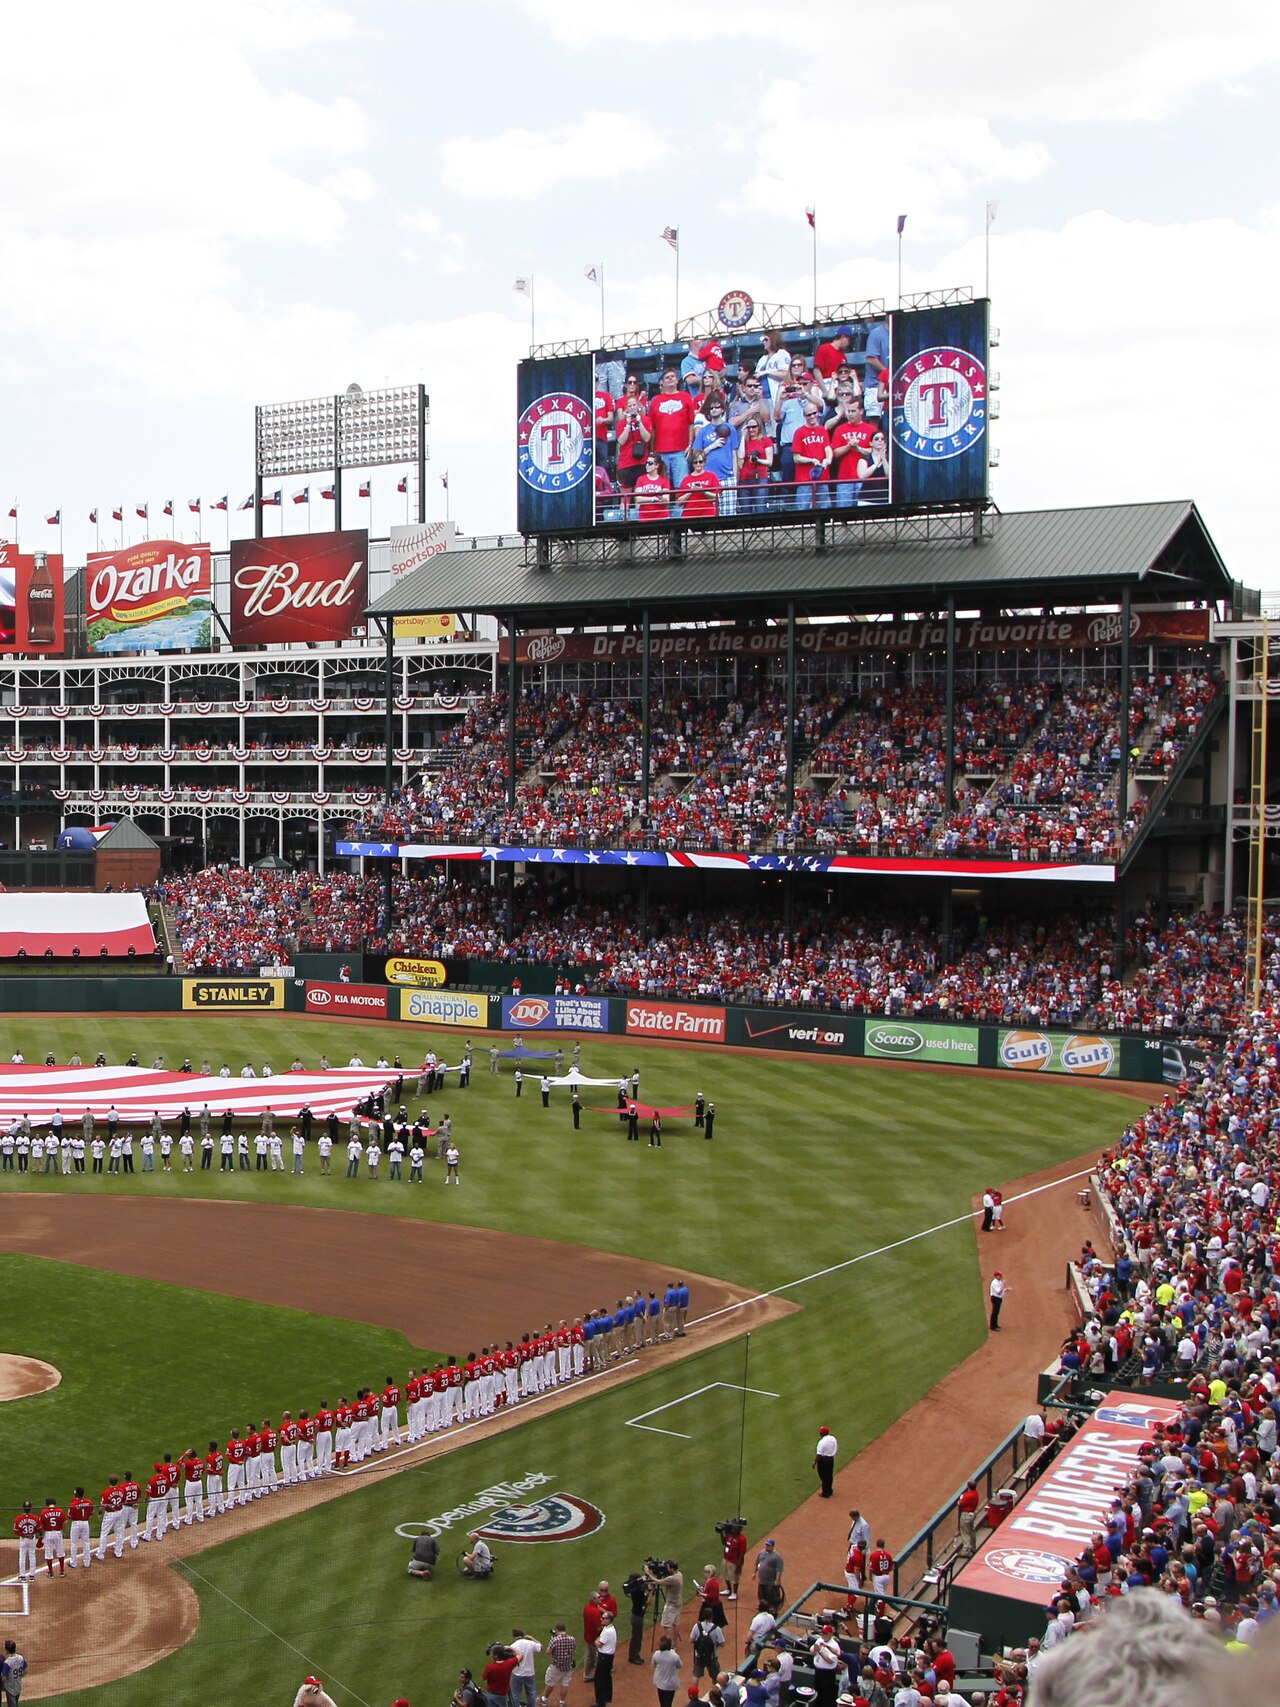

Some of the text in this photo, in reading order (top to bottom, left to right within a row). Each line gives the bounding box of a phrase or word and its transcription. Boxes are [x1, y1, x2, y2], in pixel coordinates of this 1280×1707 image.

[901, 354, 976, 384] TEXAS
[526, 399, 586, 425] TEXAS
[920, 382, 958, 428] T
[893, 408, 984, 453] RANGERS
[541, 423, 571, 464] T
[802, 435, 824, 446] TEXAS
[520, 448, 592, 486] RANGERS
[140, 551, 160, 560] QUALITY
[392, 540, 448, 575] SportsDay
[90, 553, 202, 612] Ozarka
[234, 560, 364, 617] Bud
[29, 588, 53, 599] Coca-Cola
[114, 598, 181, 620] 100% NATURAL SPRING WATER
[593, 636, 617, 656] Dr
[621, 634, 700, 658] Pepper,
[709, 630, 745, 652] the
[969, 618, 1073, 648] favorite
[528, 635, 566, 661] Dr Pepper
[64, 836, 72, 847] T
[394, 961, 438, 975] Chicken
[198, 986, 269, 1001] STANLEY
[311, 992, 328, 1002] KIA
[334, 994, 385, 1007] KIA MOTORS
[409, 994, 479, 1022] Snapple
[516, 1004, 544, 1020] DQ
[577, 1008, 601, 1016] About
[580, 1000, 601, 1009] What
[555, 1014, 603, 1029] TEXAS.
[628, 1008, 722, 1034] State Farm
[788, 1028, 844, 1044] verizon
[874, 1031, 916, 1046] Scotts
[926, 1038, 977, 1052] used here.
[1004, 1041, 1048, 1061] Gulf
[1144, 1040, 1160, 1049] 349
[1064, 1045, 1110, 1067] Gulf
[424, 1384, 432, 1392] 35
[358, 1409, 367, 1417] 46
[268, 1439, 276, 1447] 55
[234, 1449, 244, 1458] 57
[170, 1472, 177, 1482] 17
[158, 1485, 165, 1494] 10
[1010, 1431, 1148, 1544] RANGERS
[126, 1492, 137, 1500] 29
[394, 1472, 558, 1538] Opening Week
[50, 1517, 56, 1526] 5
[22, 1525, 34, 1534] 38
